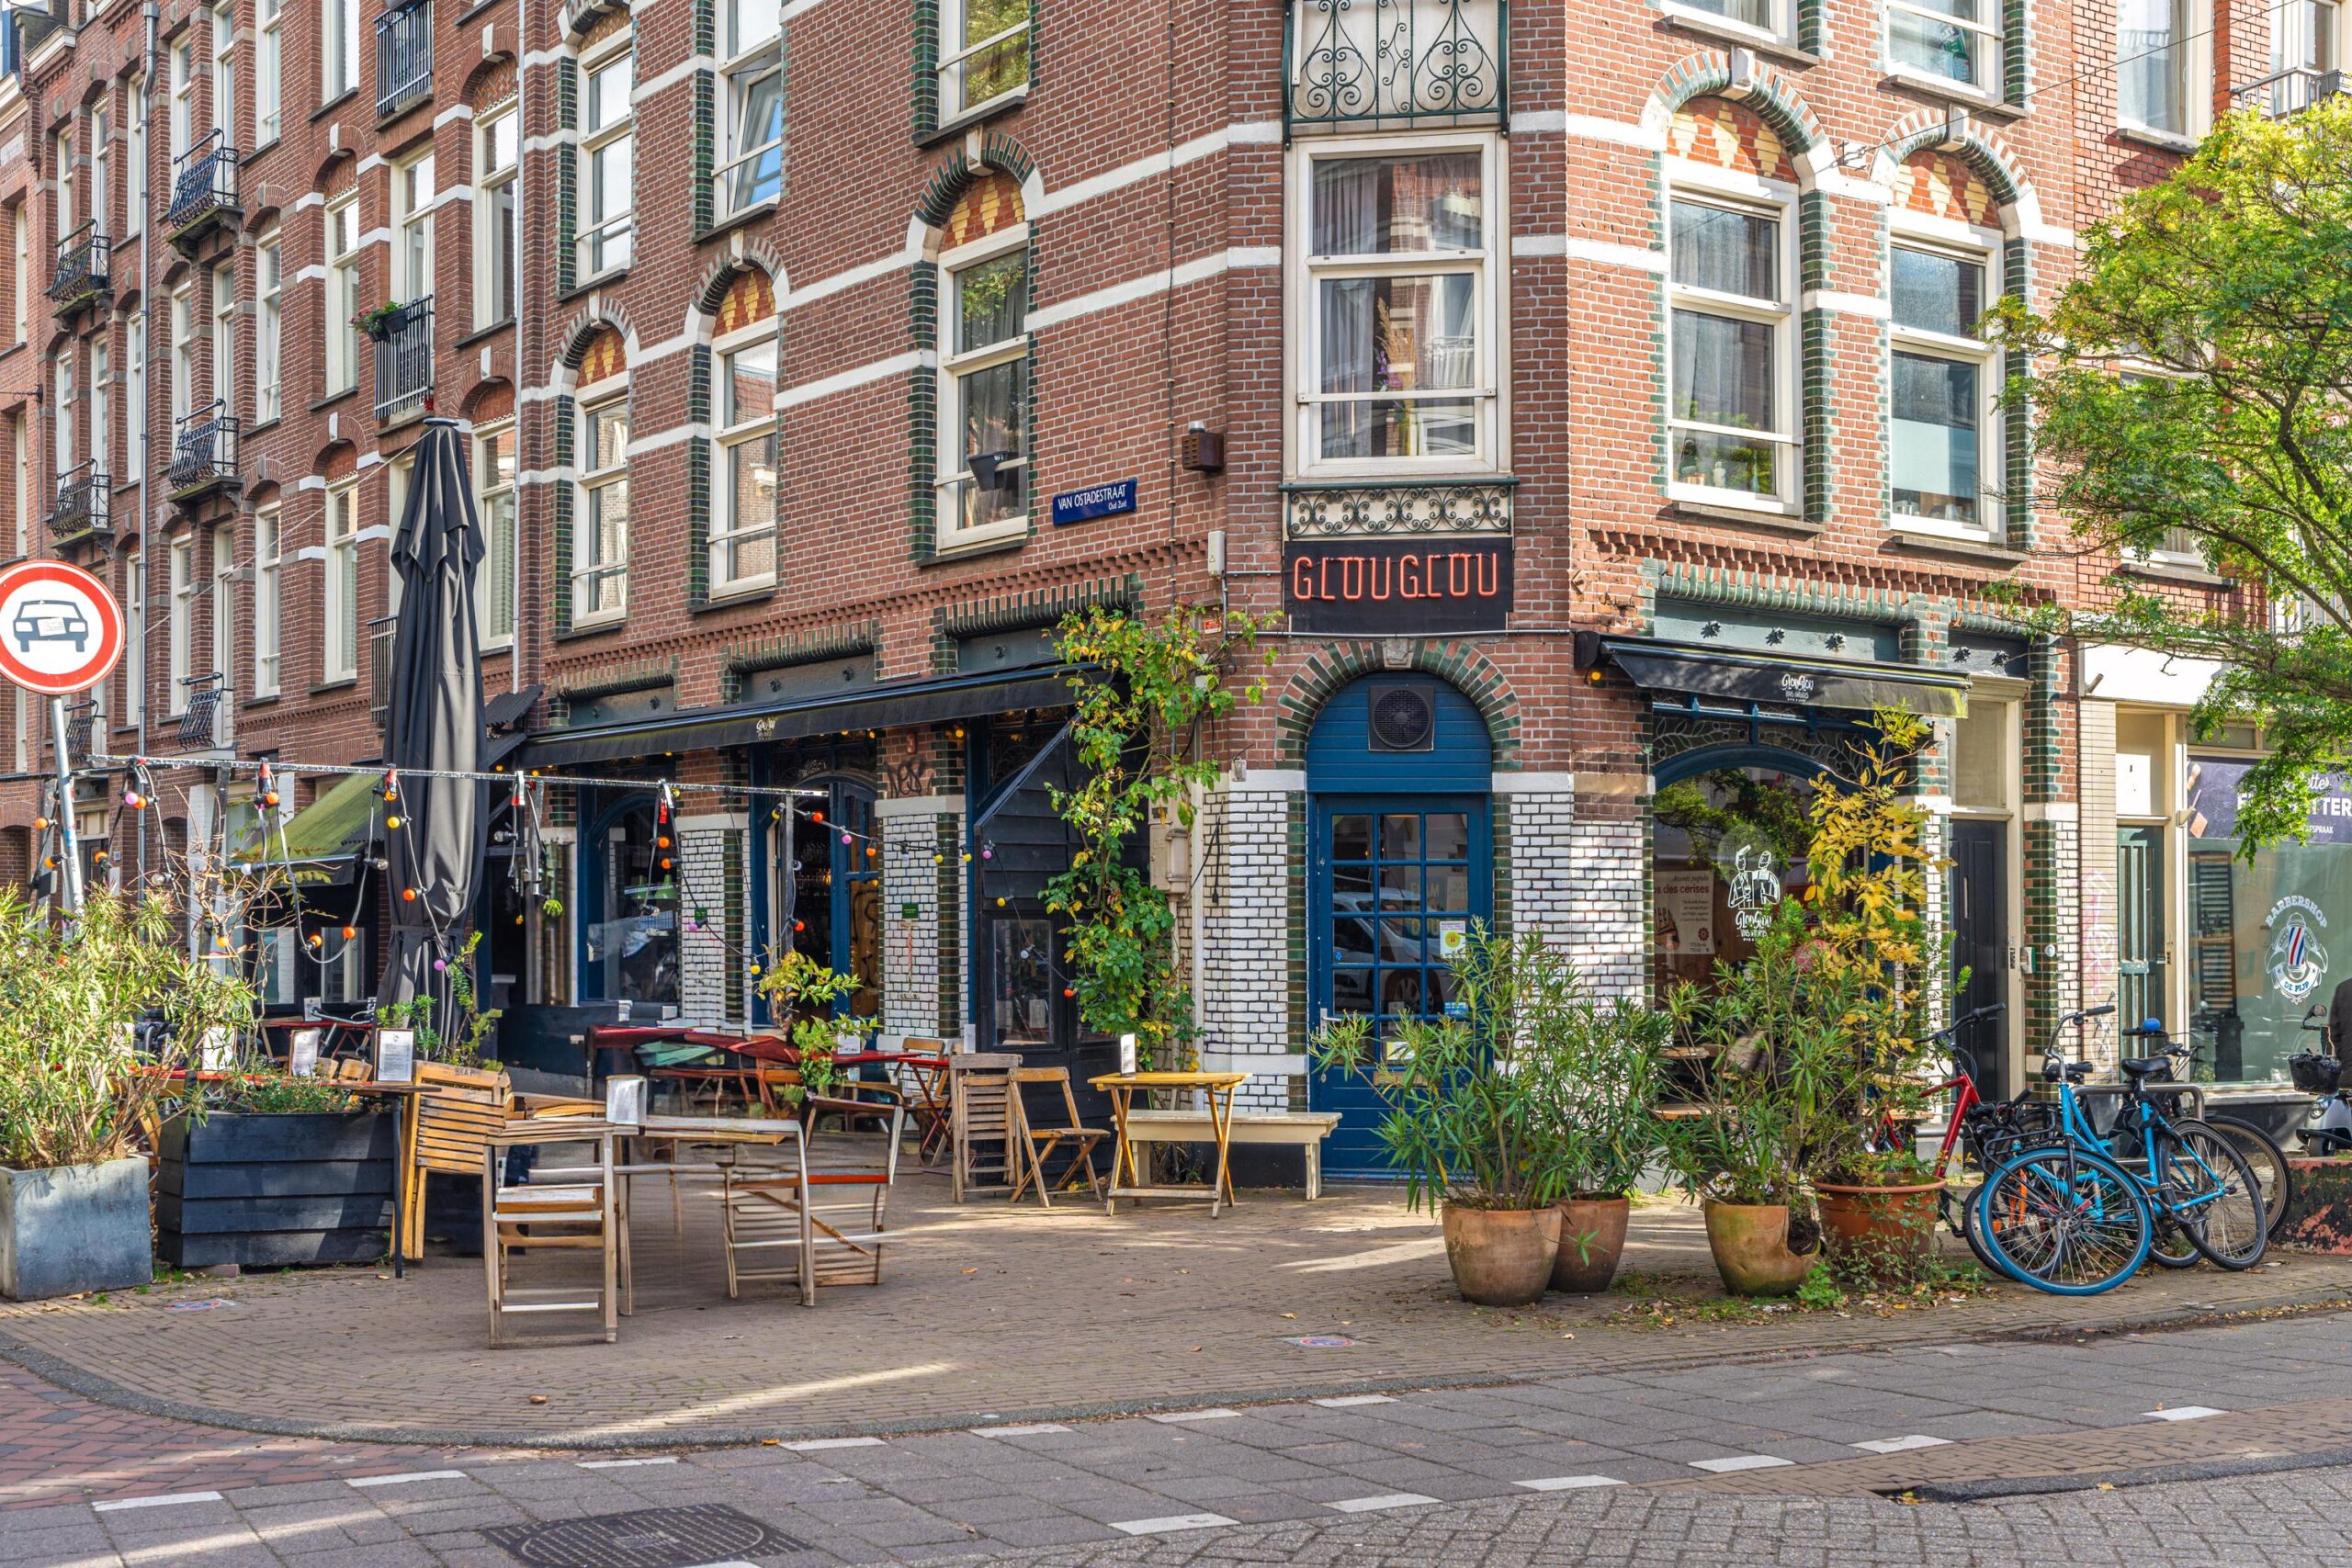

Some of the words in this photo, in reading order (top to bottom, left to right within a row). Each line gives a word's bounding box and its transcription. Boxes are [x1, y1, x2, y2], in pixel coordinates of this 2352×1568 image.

[1057, 496, 1073, 511] VAN
[1074, 484, 1126, 507] OSTADESTRAAT
[1108, 501, 1117, 511] Oud
[1117, 499, 1127, 509] Zuid
[1294, 553, 1498, 600] GLOUGLOU
[1663, 885, 1678, 894] des
[1680, 884, 1710, 894] cerises
[2265, 896, 2327, 928] BARBERSHOP
[2284, 981, 2293, 991] DE
[2294, 981, 2310, 992] PIJP
